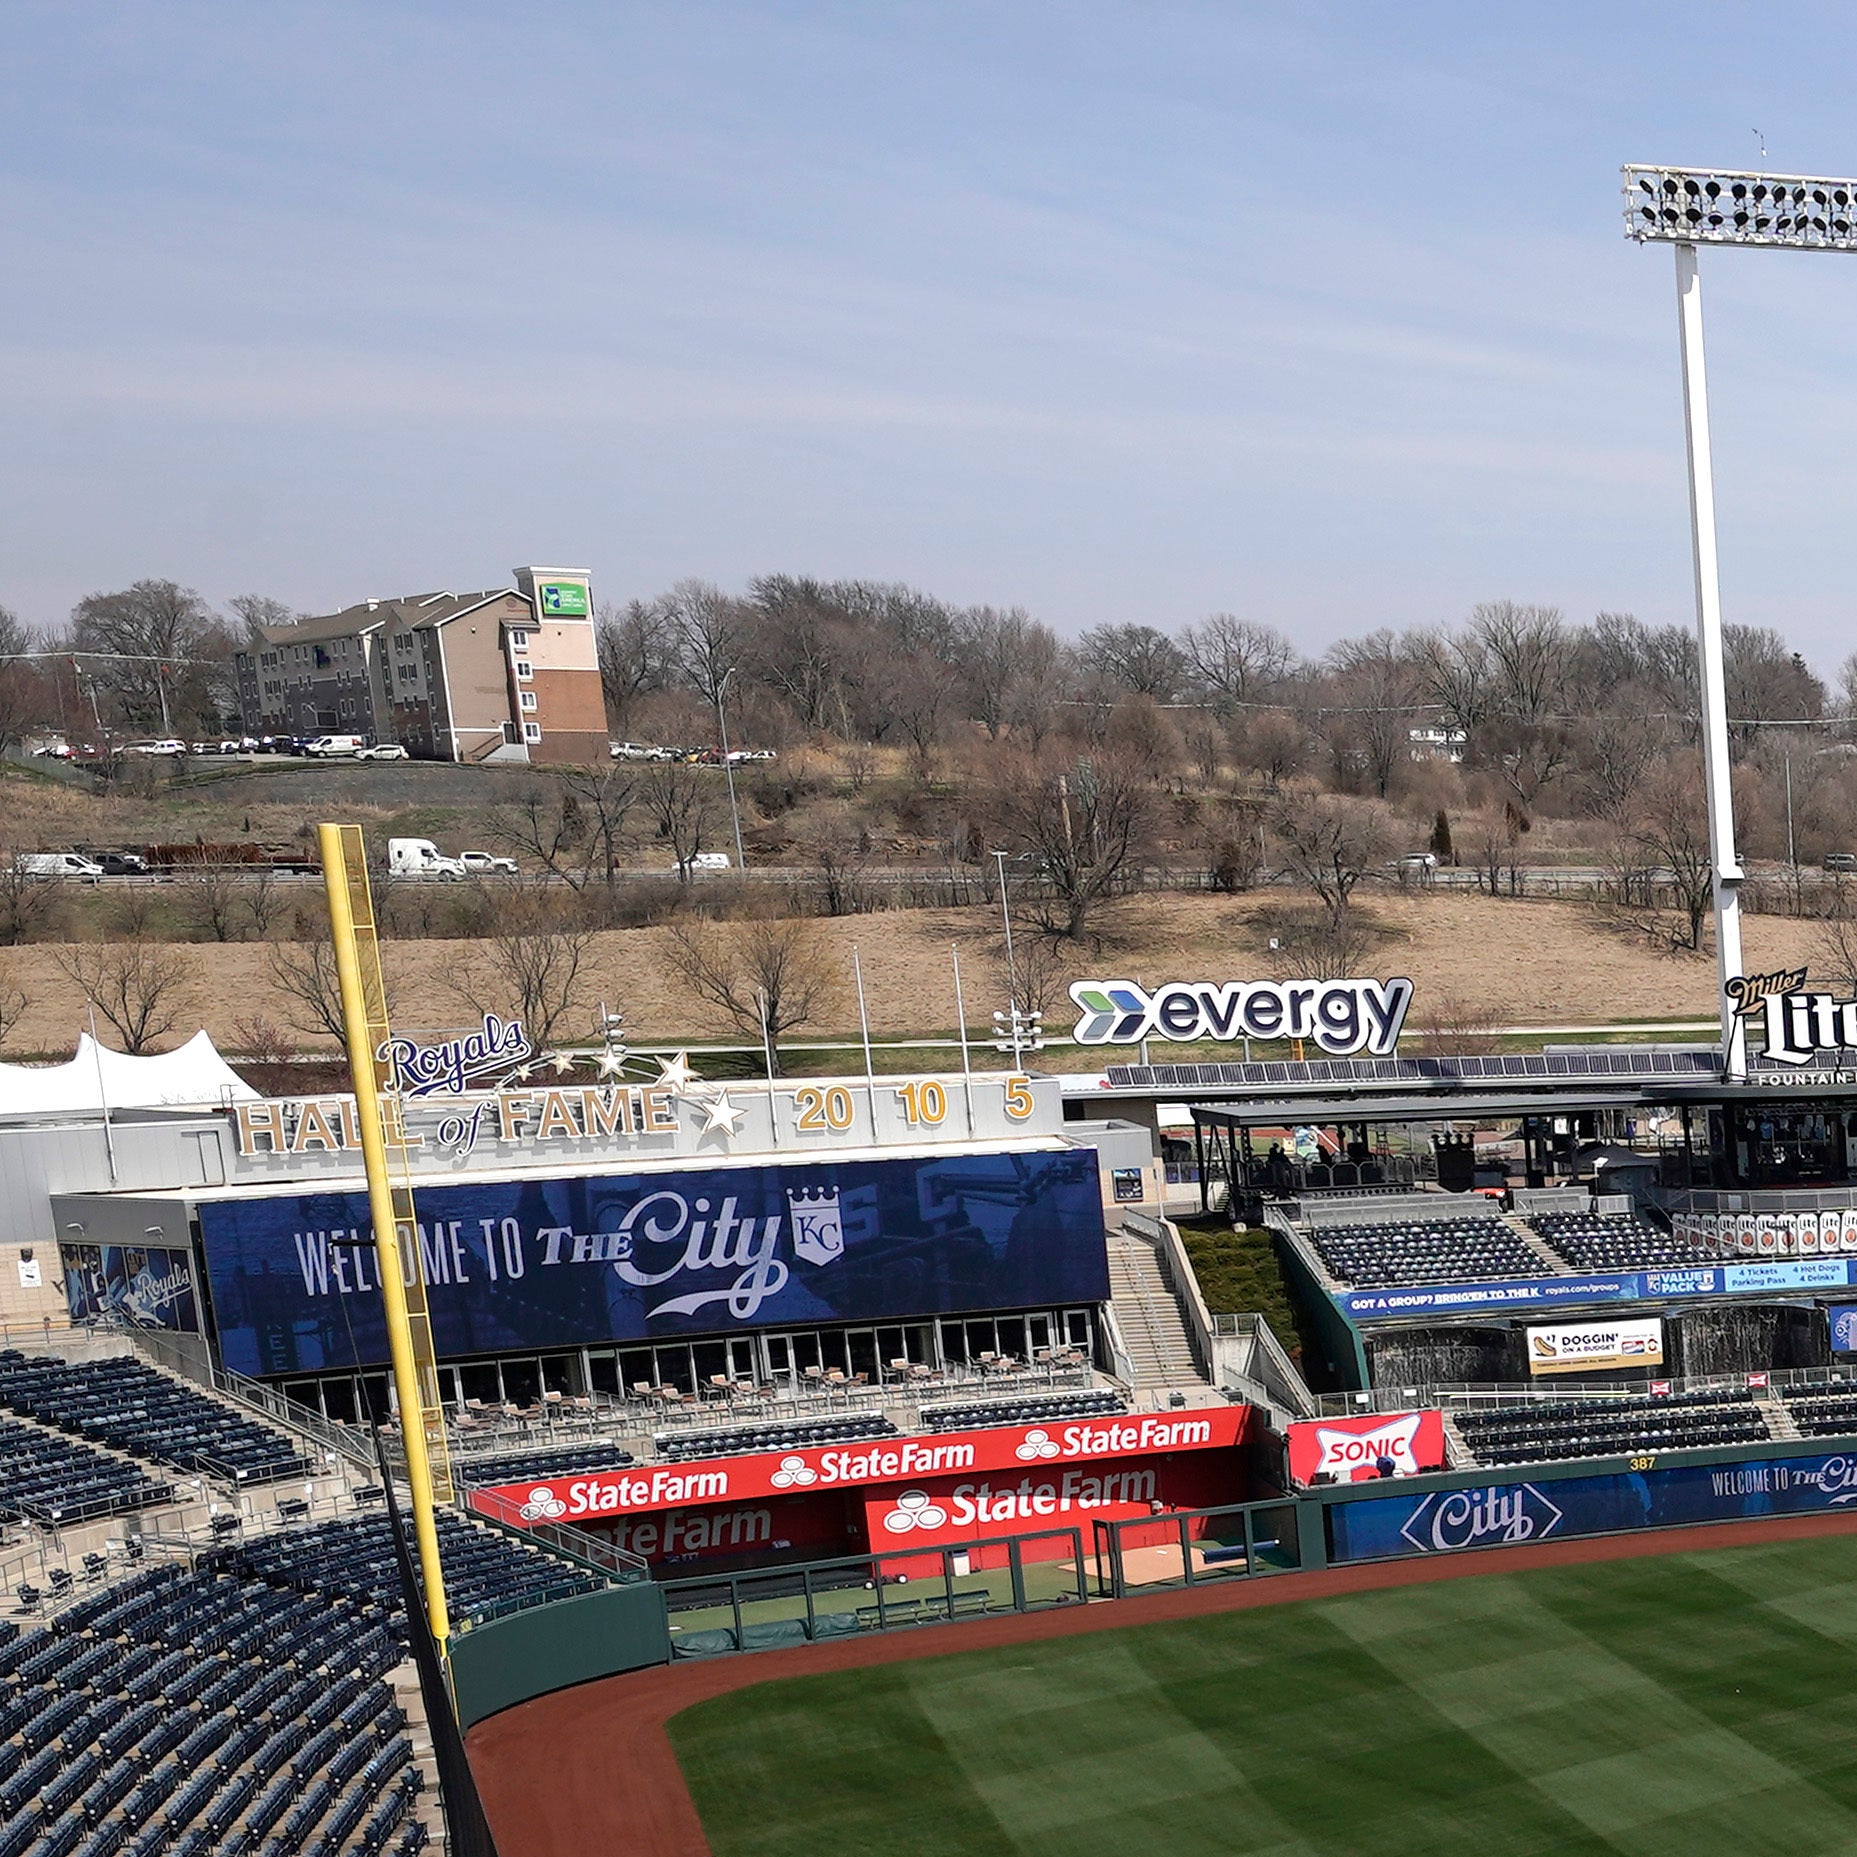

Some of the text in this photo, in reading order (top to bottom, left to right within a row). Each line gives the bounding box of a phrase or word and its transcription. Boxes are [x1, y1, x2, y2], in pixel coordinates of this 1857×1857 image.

[1727, 971, 1804, 1013] Miller
[1160, 984, 1409, 1051] evergy
[377, 1013, 532, 1098] Royals
[1758, 1072, 1847, 1086] FOUNTAIN
[794, 1075, 1035, 1132] 20 10 5
[235, 1086, 681, 1157] HALL of FAME
[295, 1219, 471, 1299] WELOME
[478, 1218, 524, 1282] TO
[537, 1226, 634, 1266] THE
[611, 1190, 789, 1320] City
[1662, 1273, 1703, 1284] VALUE
[1732, 1275, 1787, 1288] Parking Pass
[1747, 1267, 1779, 1276] Tickets
[137, 1263, 192, 1310] Royals
[1351, 1298, 1376, 1310] GOT
[1377, 1297, 1388, 1308] A
[1388, 1294, 1433, 1308] GROUP?
[1490, 1290, 1506, 1302] TO
[1545, 1282, 1620, 1296] royals.com/groups
[1662, 1282, 1697, 1294] PACK
[1562, 1332, 1619, 1346] DOGGIN'
[1562, 1346, 1574, 1354] ON
[1584, 1343, 1617, 1352] BUDGET
[1328, 1435, 1406, 1464] SONIC
[1629, 1456, 1656, 1471] 387
[1712, 1468, 1771, 1498] WELCOME
[1774, 1467, 1789, 1491] TO
[1793, 1469, 1824, 1485] THE
[1431, 1484, 1535, 1549] City
